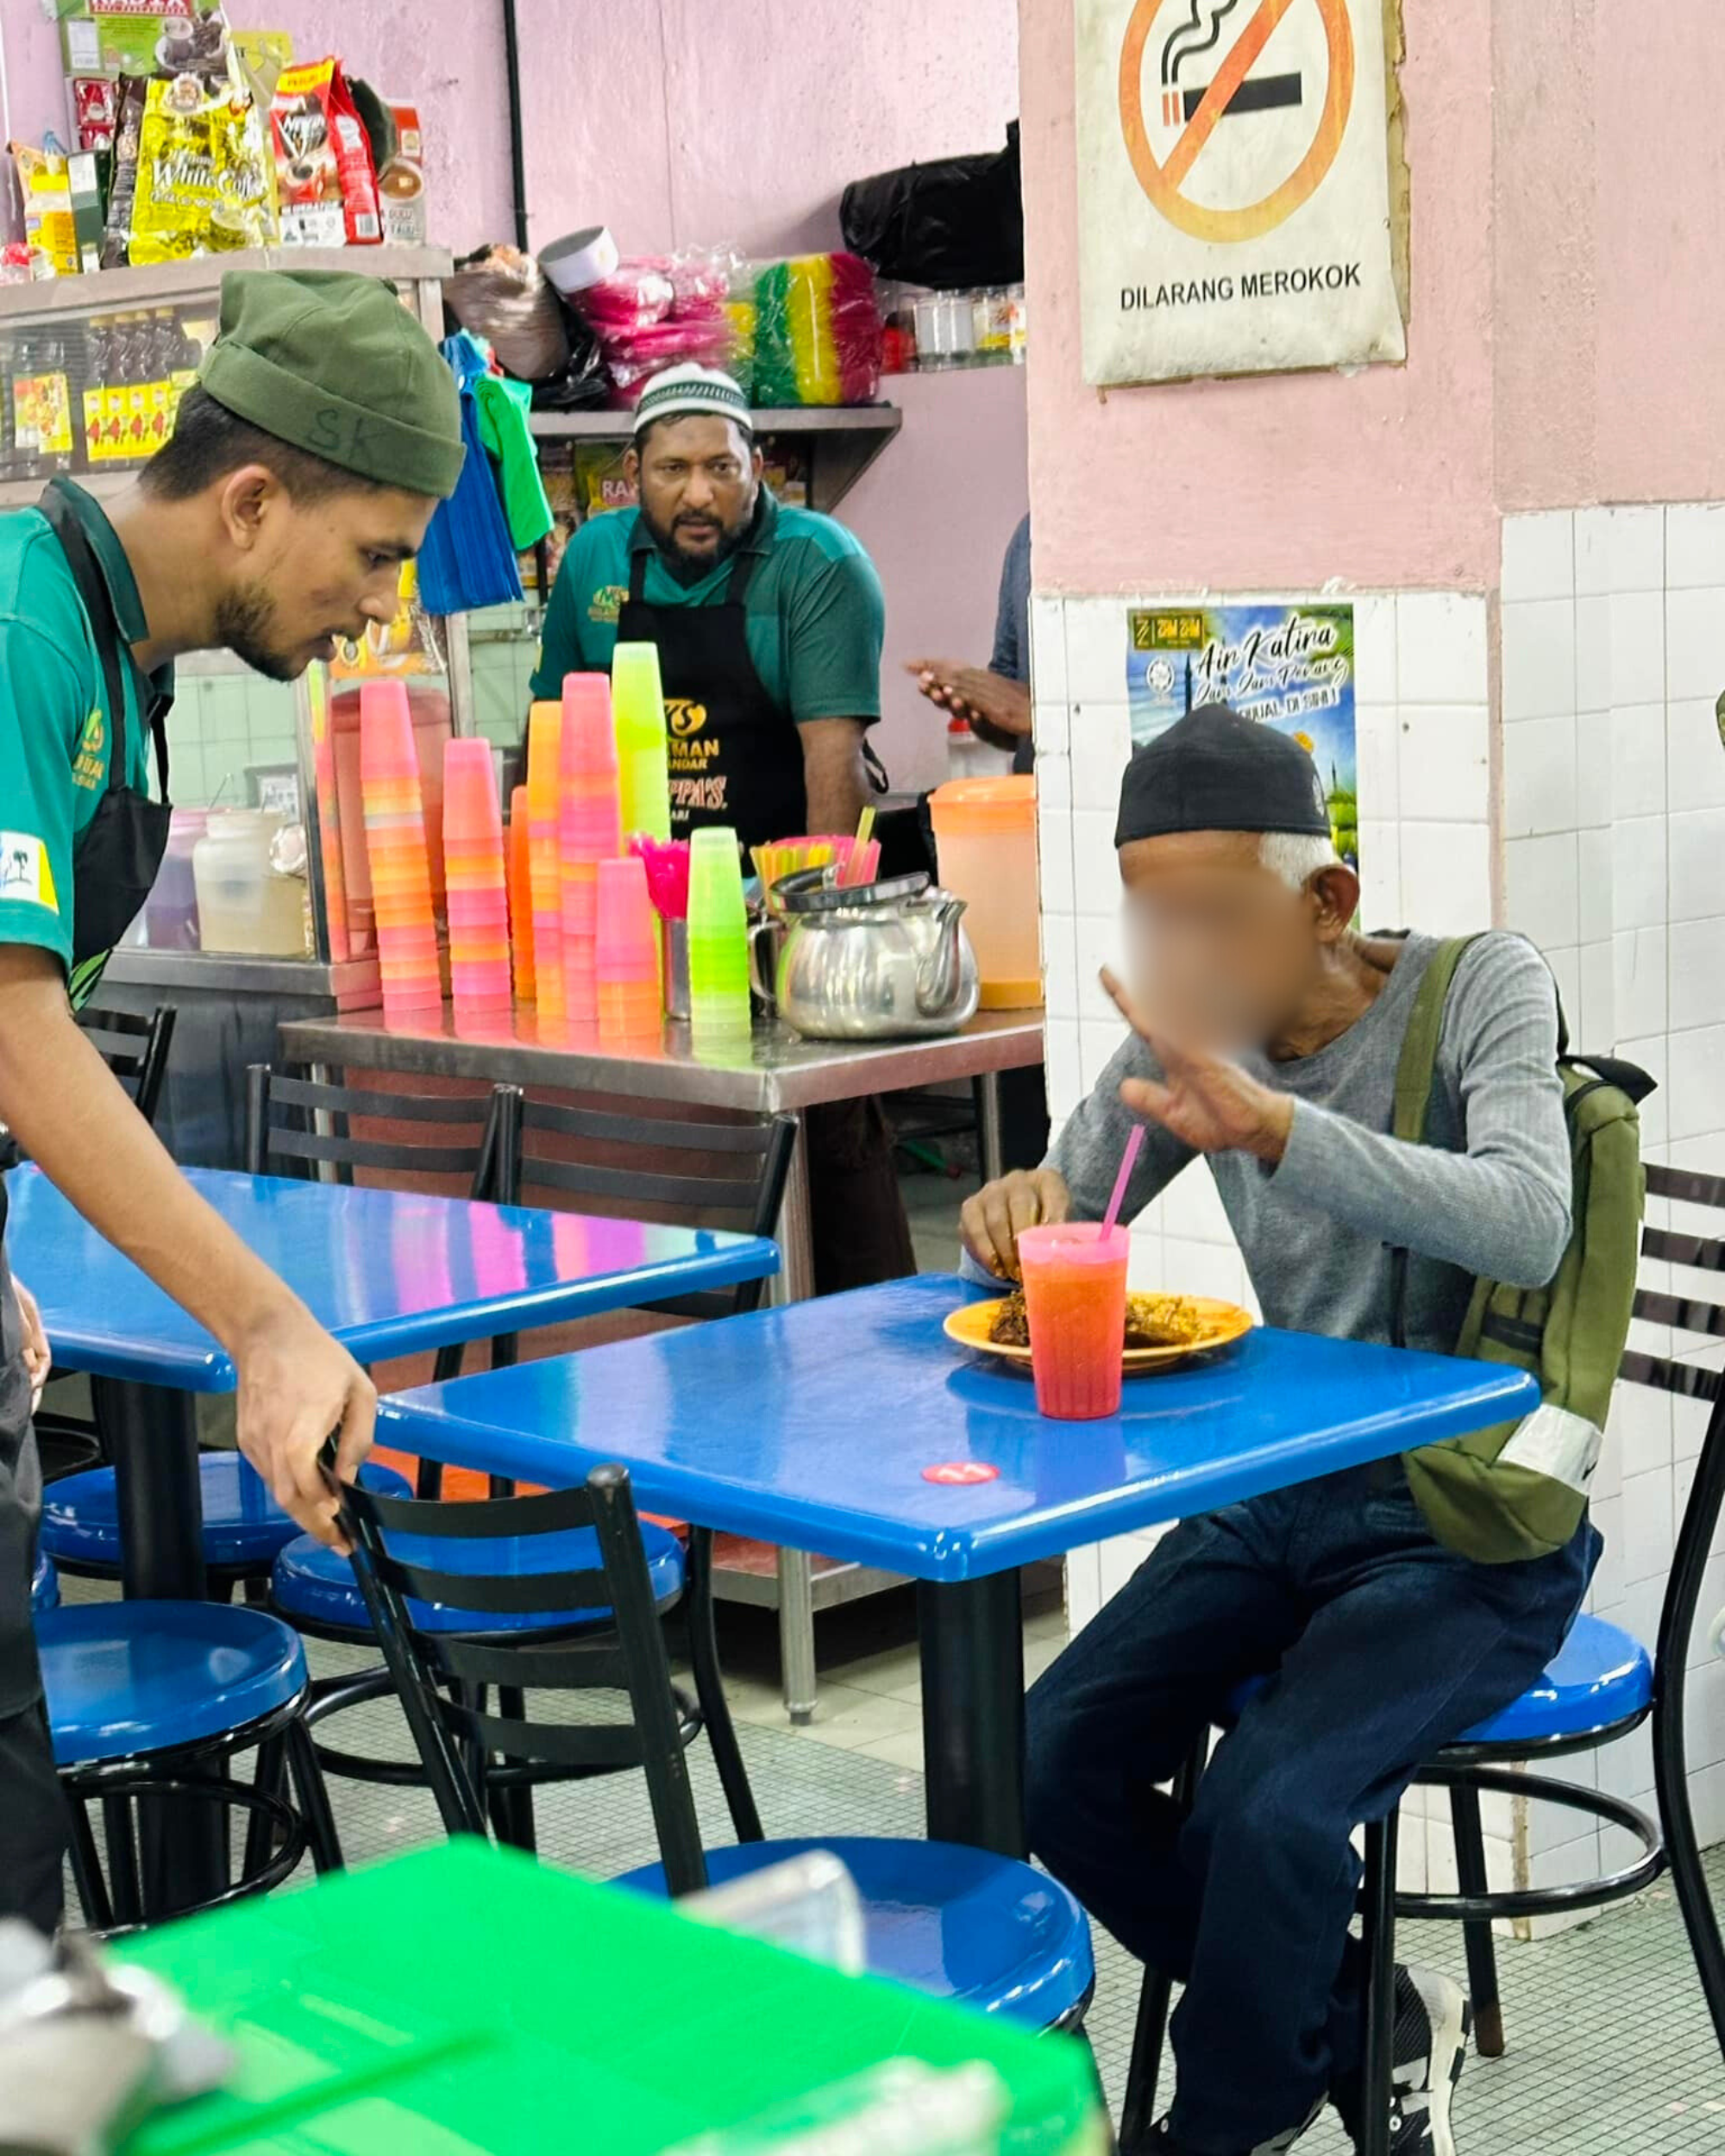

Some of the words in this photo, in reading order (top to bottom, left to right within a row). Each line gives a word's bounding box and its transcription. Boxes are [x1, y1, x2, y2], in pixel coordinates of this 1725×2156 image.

[1121, 279, 1233, 310] DILARANG
[1241, 263, 1361, 298] MEROKOK
[1195, 642, 1239, 679] Air
[1245, 615, 1334, 667] Katira
[668, 738, 719, 757] MAN
